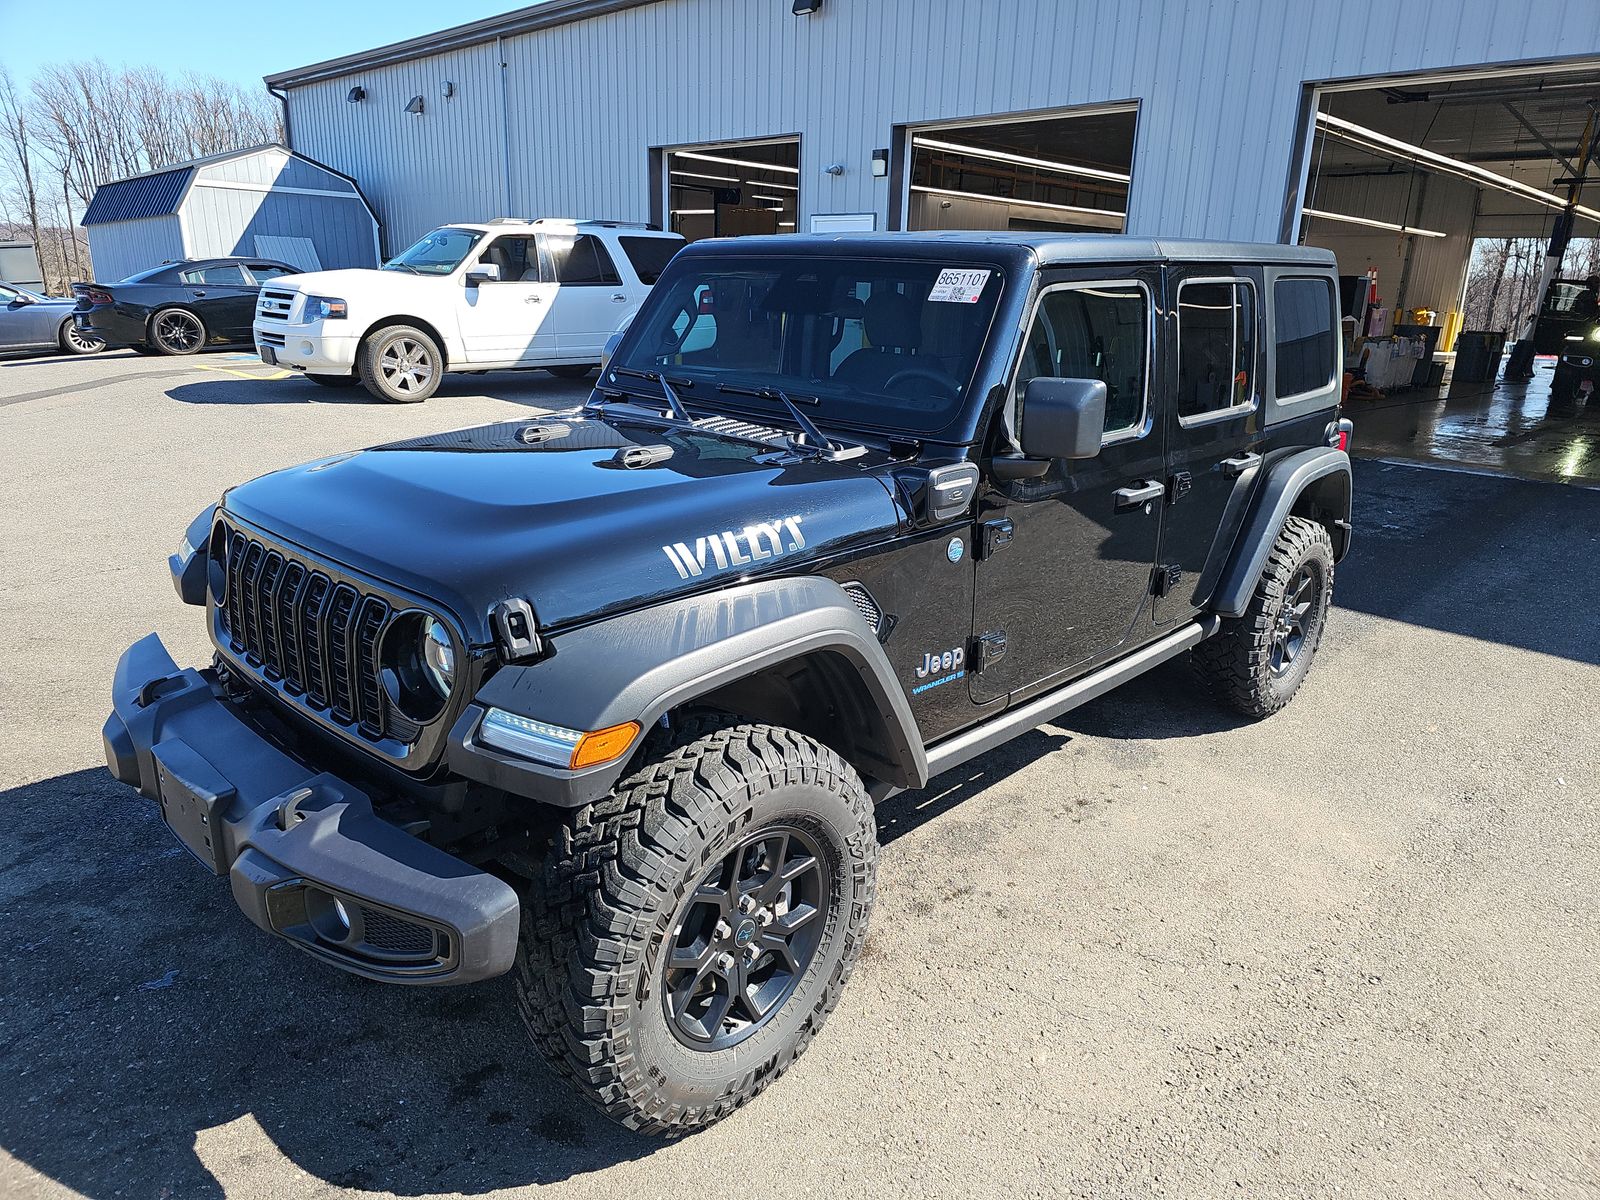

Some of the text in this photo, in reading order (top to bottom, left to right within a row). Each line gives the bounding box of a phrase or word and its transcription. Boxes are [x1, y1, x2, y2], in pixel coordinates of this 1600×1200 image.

[938, 272, 988, 286] 8651101
[662, 515, 806, 580] WILLYS
[915, 647, 964, 678] Jeep
[912, 673, 957, 695] WRANGLER
